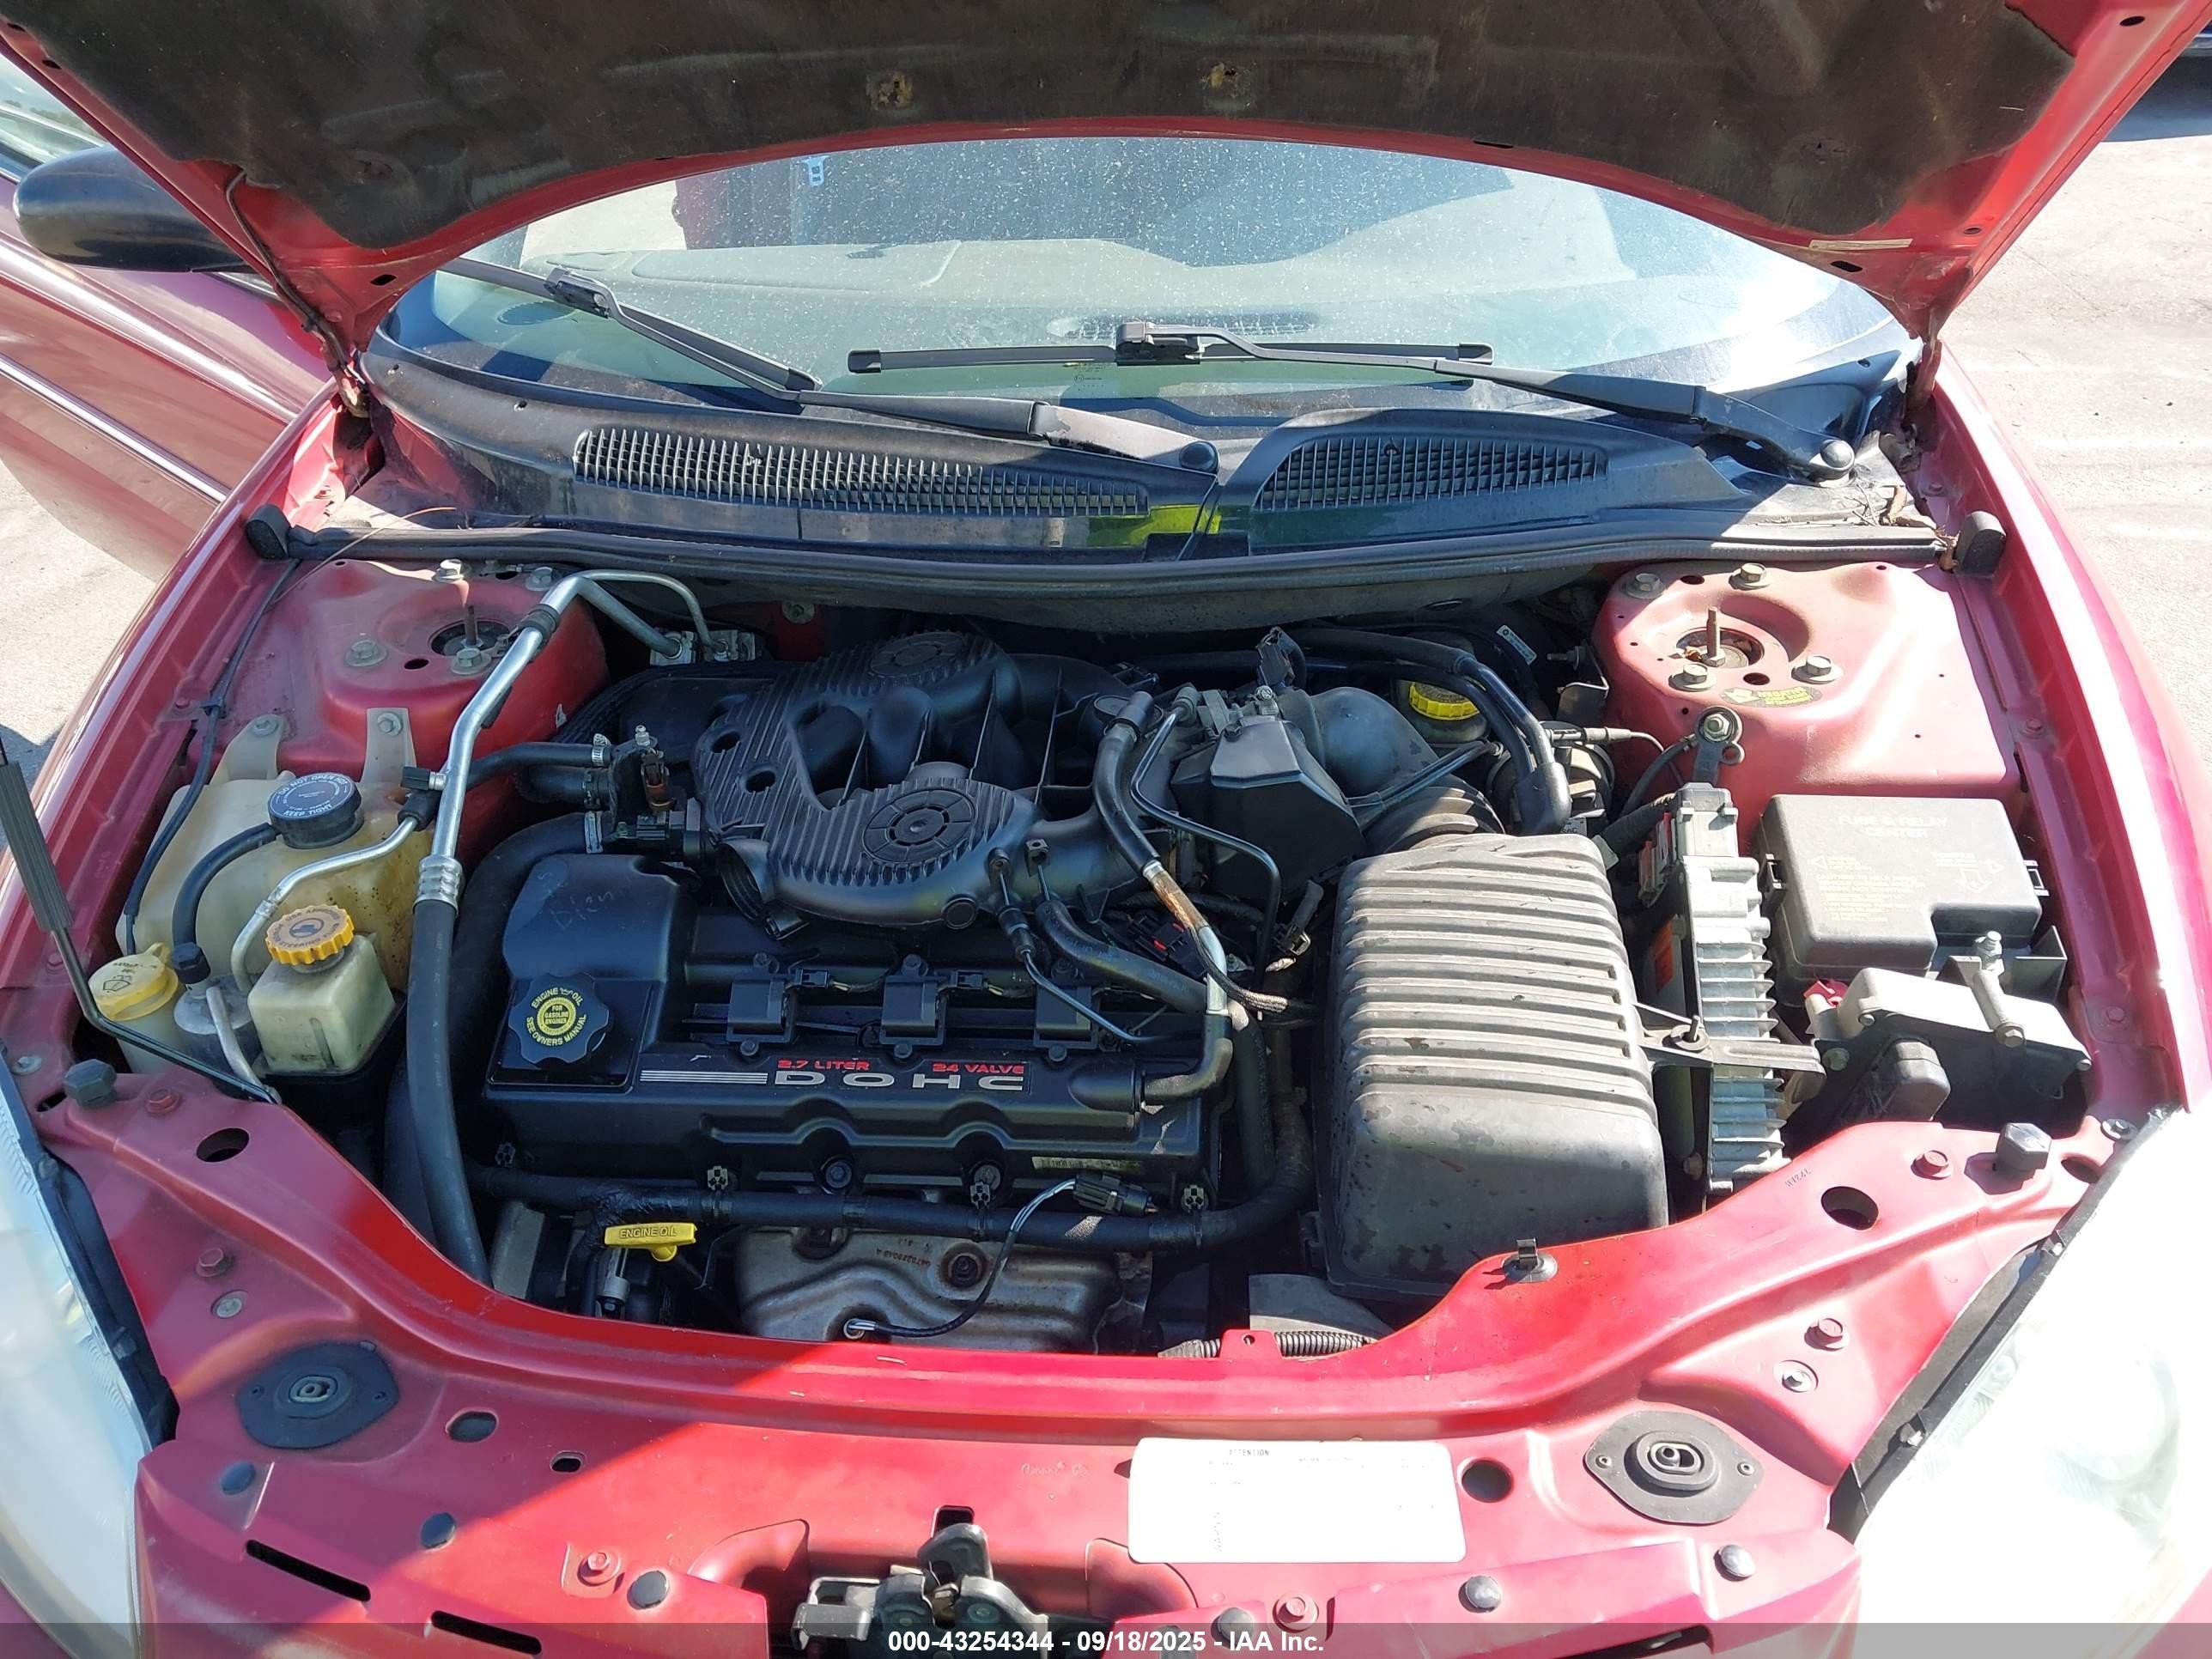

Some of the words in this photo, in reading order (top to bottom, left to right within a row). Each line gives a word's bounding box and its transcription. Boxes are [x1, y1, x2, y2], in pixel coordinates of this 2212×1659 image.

[309, 803, 333, 815] TIGHT
[1865, 827, 1929, 838] CENTER
[531, 988, 559, 1009] ENGINE
[571, 992, 584, 1007] OIL
[526, 1016, 537, 1034] SEE
[563, 1013, 587, 1042] MANUAL
[777, 1060, 809, 1070] 2.7
[814, 1060, 871, 1071] LITER
[933, 1063, 959, 1073] 24
[964, 1064, 1025, 1074] VALVE
[775, 1070, 1024, 1091] DOHC
[619, 1227, 658, 1238] ENGINE
[659, 1226, 678, 1237] OIL
